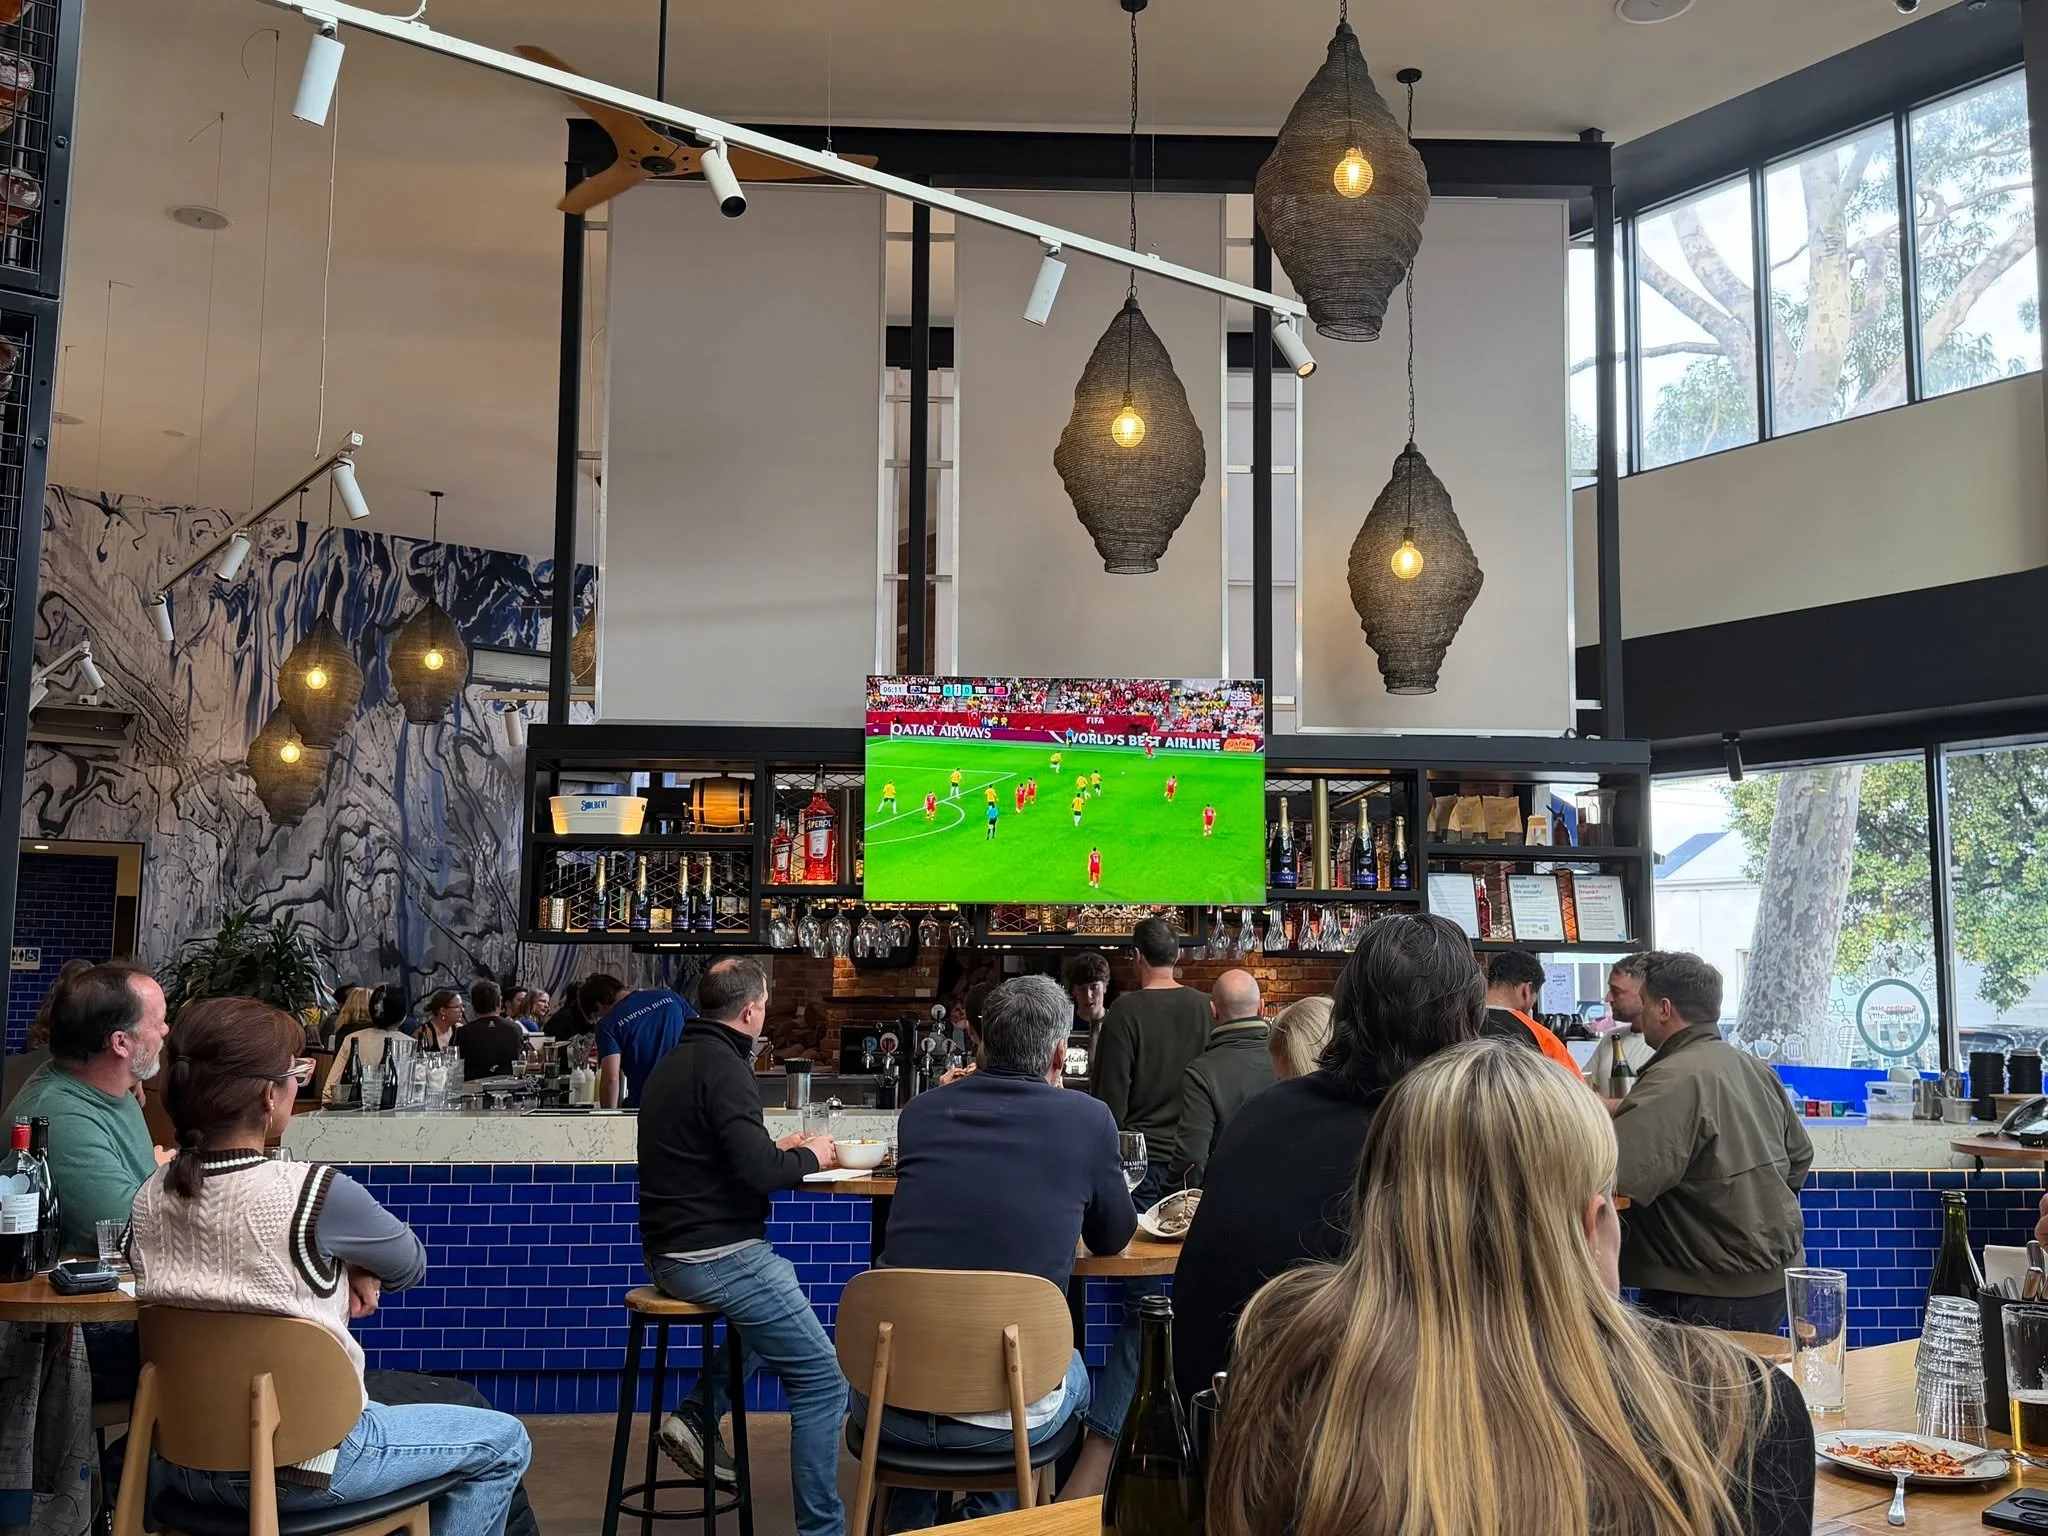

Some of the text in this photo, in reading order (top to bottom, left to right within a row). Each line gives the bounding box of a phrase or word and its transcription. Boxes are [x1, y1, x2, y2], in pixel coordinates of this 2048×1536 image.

[1230, 691, 1252, 701] SBS
[1086, 716, 1104, 724] FIFA
[892, 724, 992, 738] QATAR AIRWAYS
[1070, 732, 1221, 750] WORLD'S BEST AIRLINE
[806, 819, 832, 830] APEROL
[617, 997, 673, 1027] HAMPTON HOTEL
